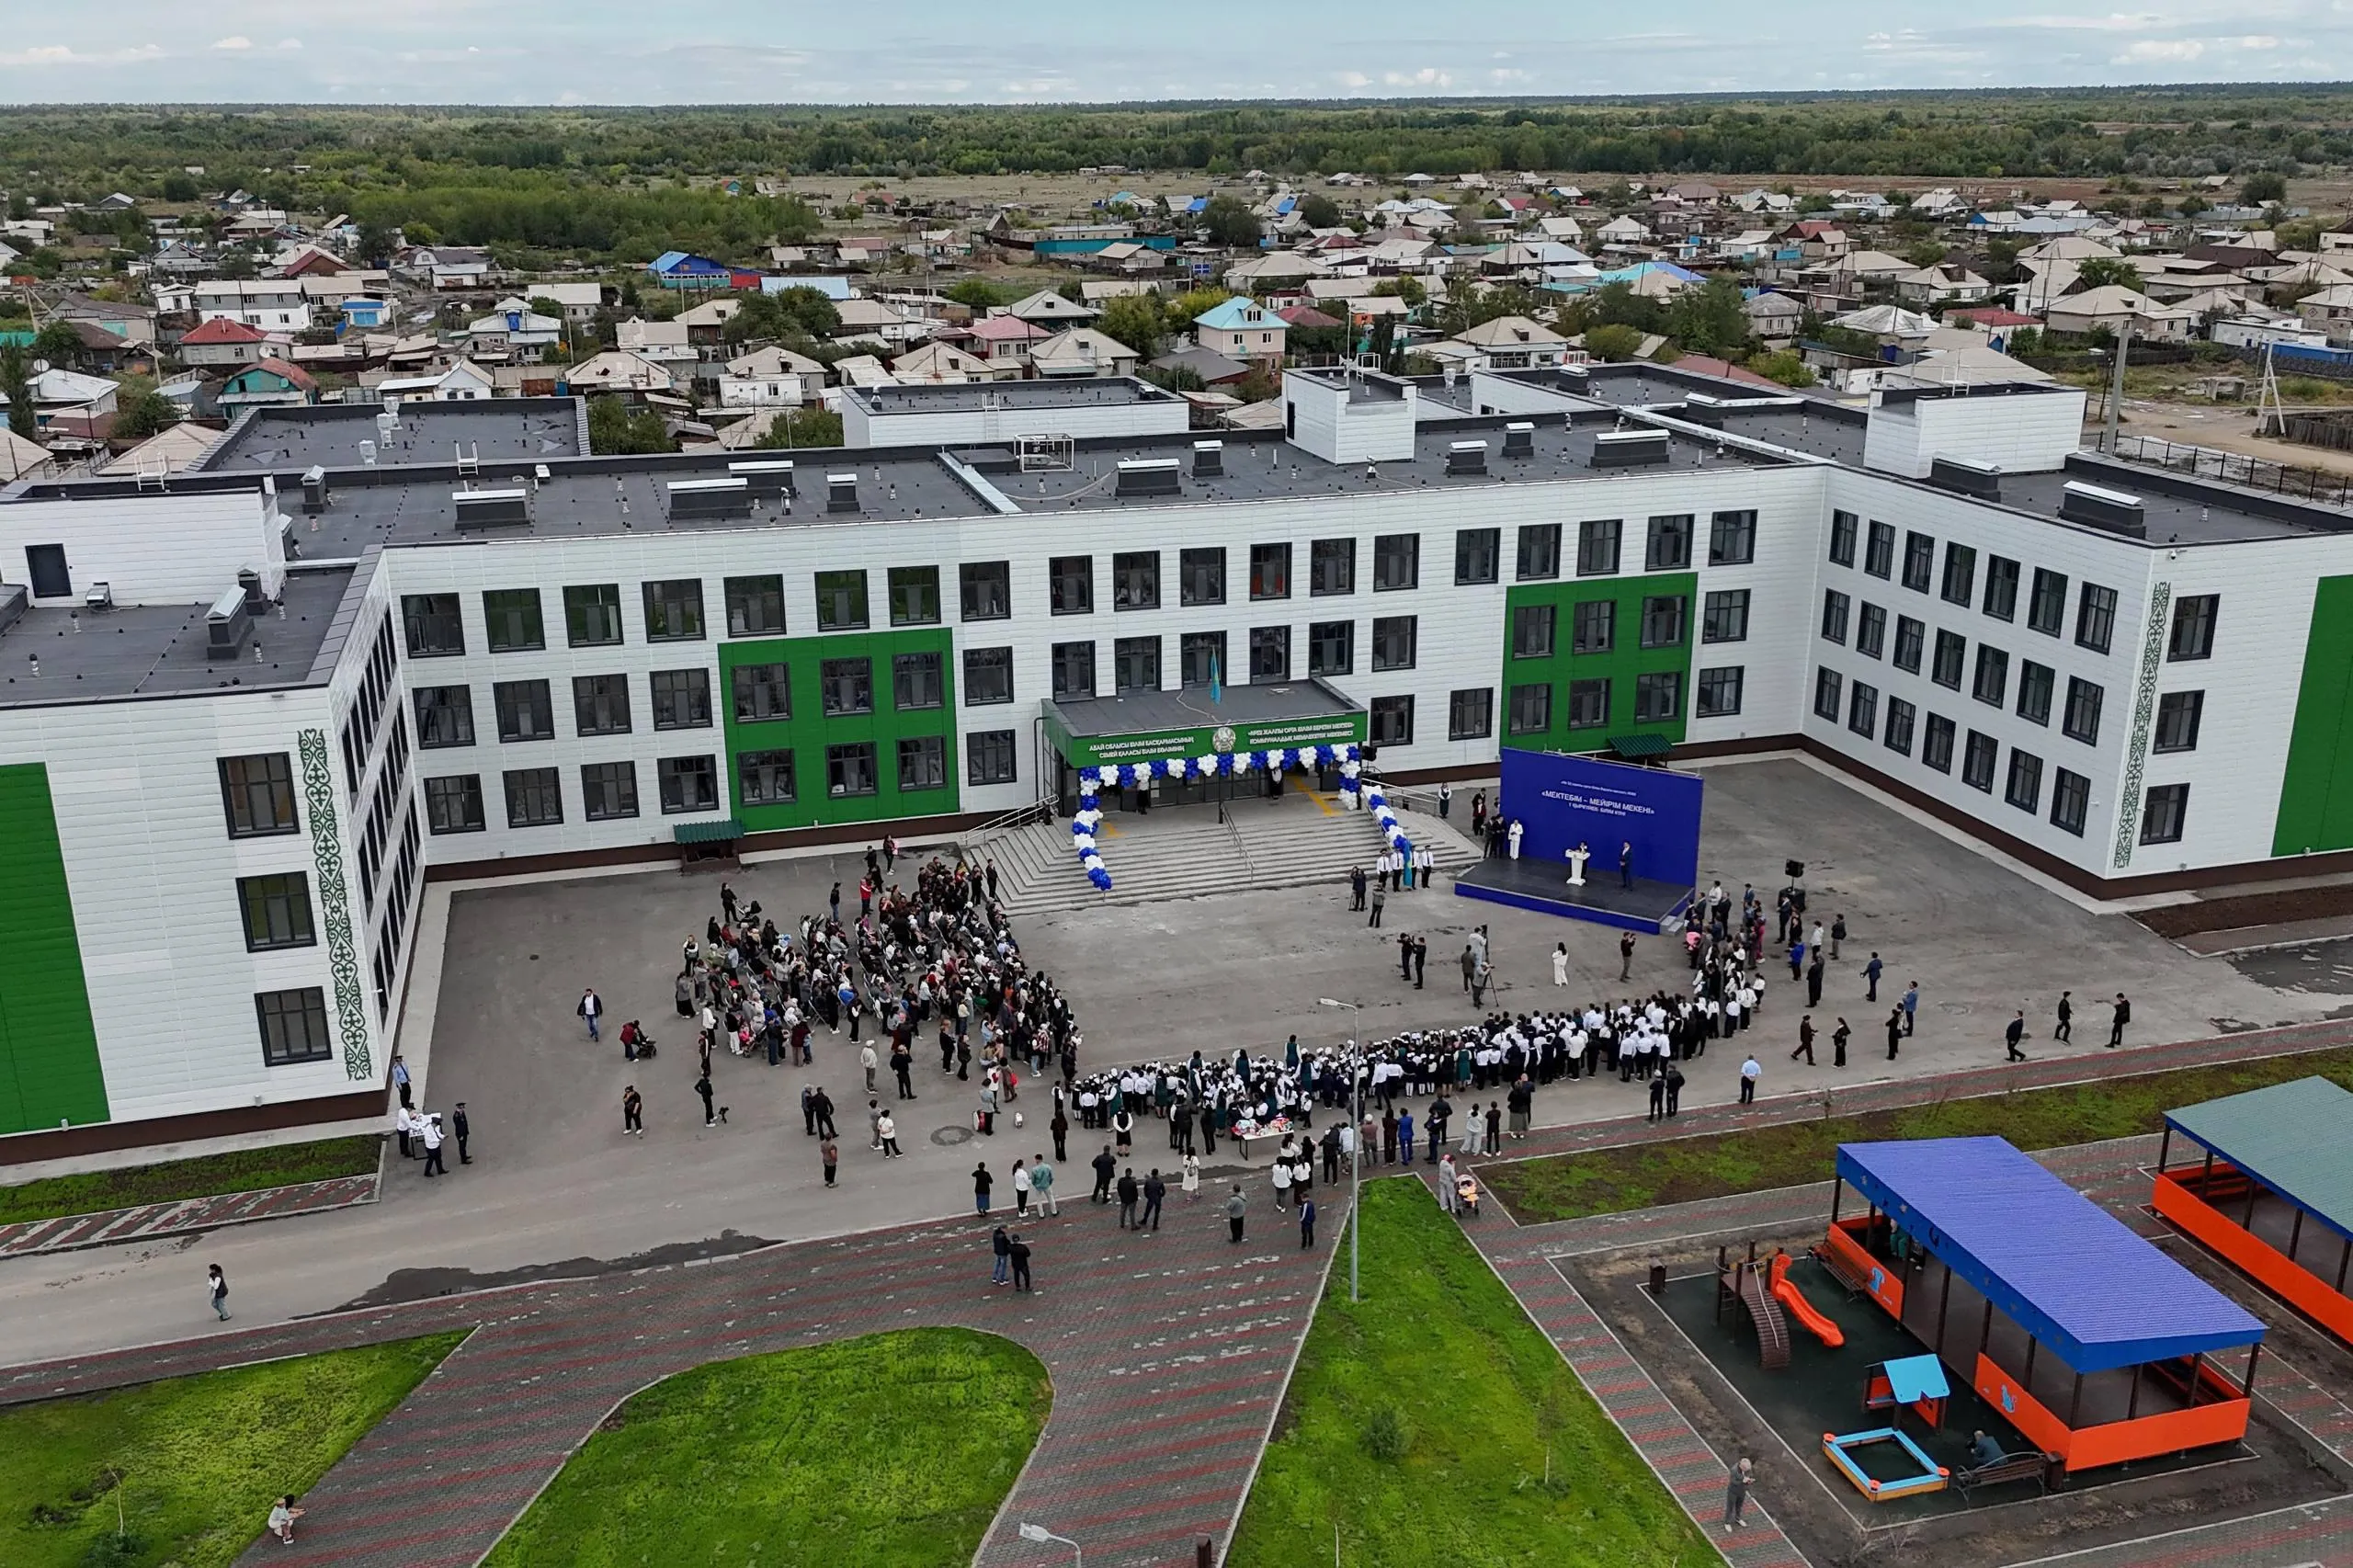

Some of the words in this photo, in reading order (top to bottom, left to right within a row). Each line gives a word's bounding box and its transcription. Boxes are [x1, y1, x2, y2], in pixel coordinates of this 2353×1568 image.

[1541, 790, 1583, 802] «МЕКТЕБІМ
[1588, 797, 1621, 810] МЕЙІРІМ
[1621, 802, 1655, 814] МЕКЕНІ»
